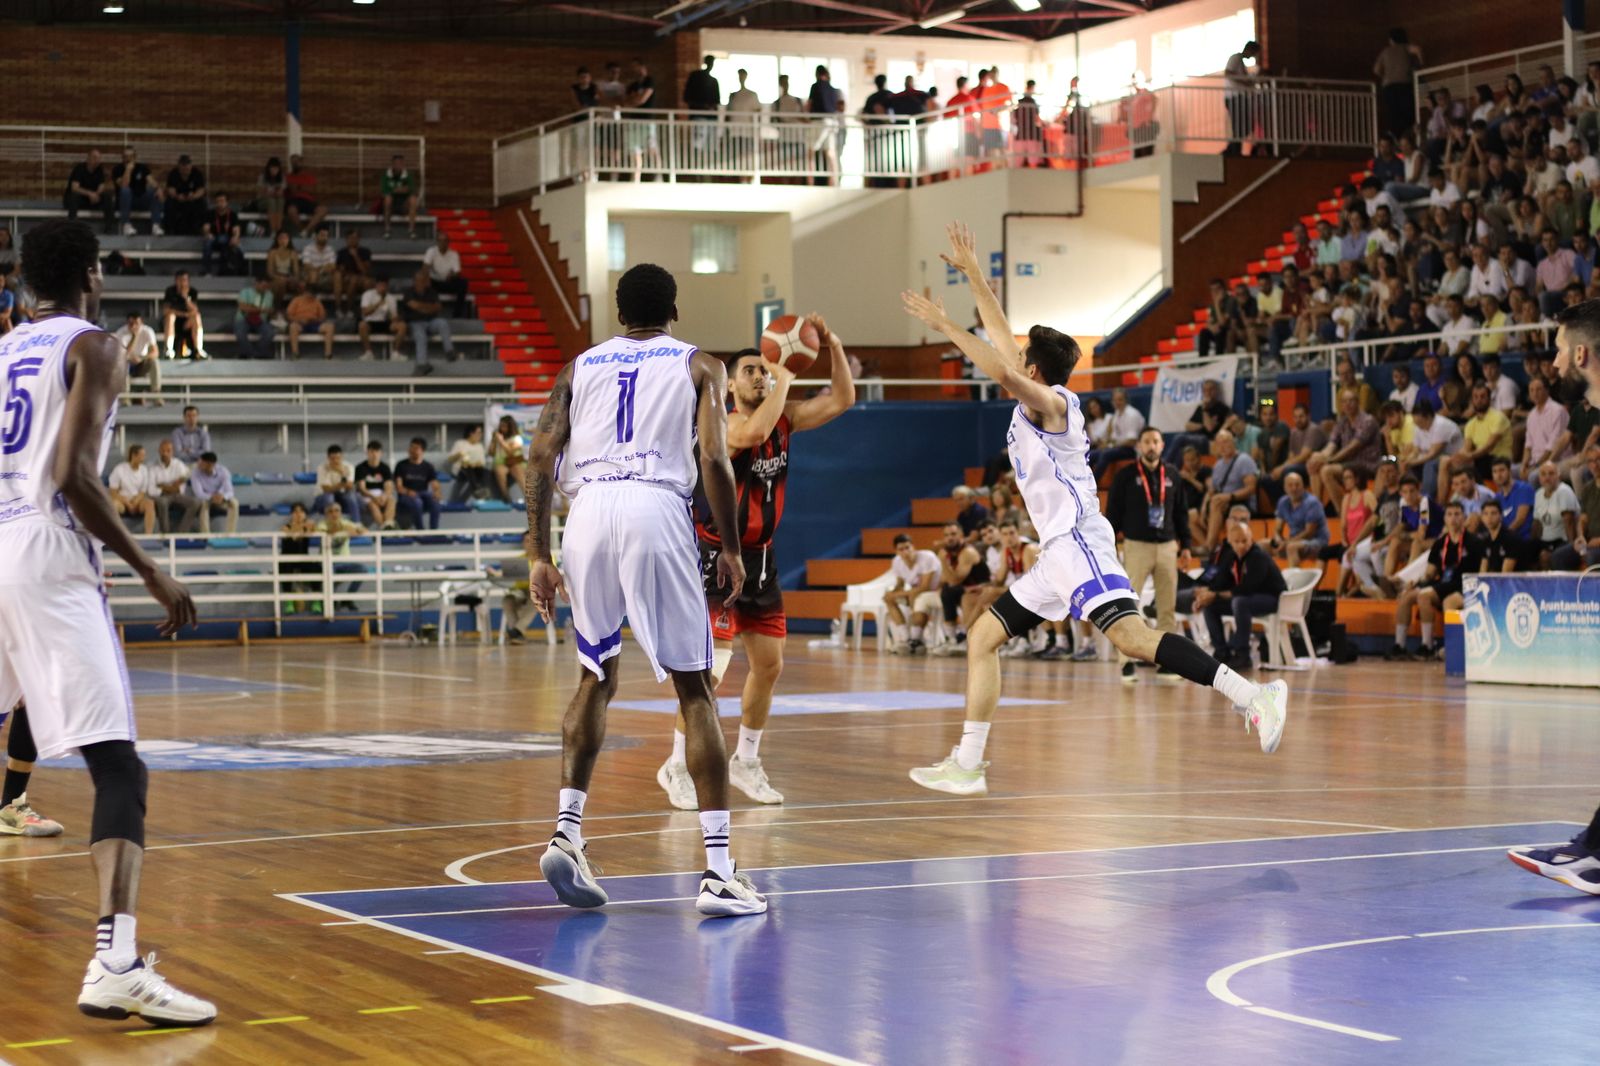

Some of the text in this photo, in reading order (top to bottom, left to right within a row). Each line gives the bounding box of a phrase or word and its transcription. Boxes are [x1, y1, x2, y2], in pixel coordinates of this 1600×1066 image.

[583, 347, 684, 366] NICKERSON
[1, 357, 44, 455] 5
[616, 367, 639, 444] 1
[574, 456, 599, 470] Huelva
[1540, 599, 1600, 614] Ayuntamiento
[1554, 612, 1600, 624] de Huelva
